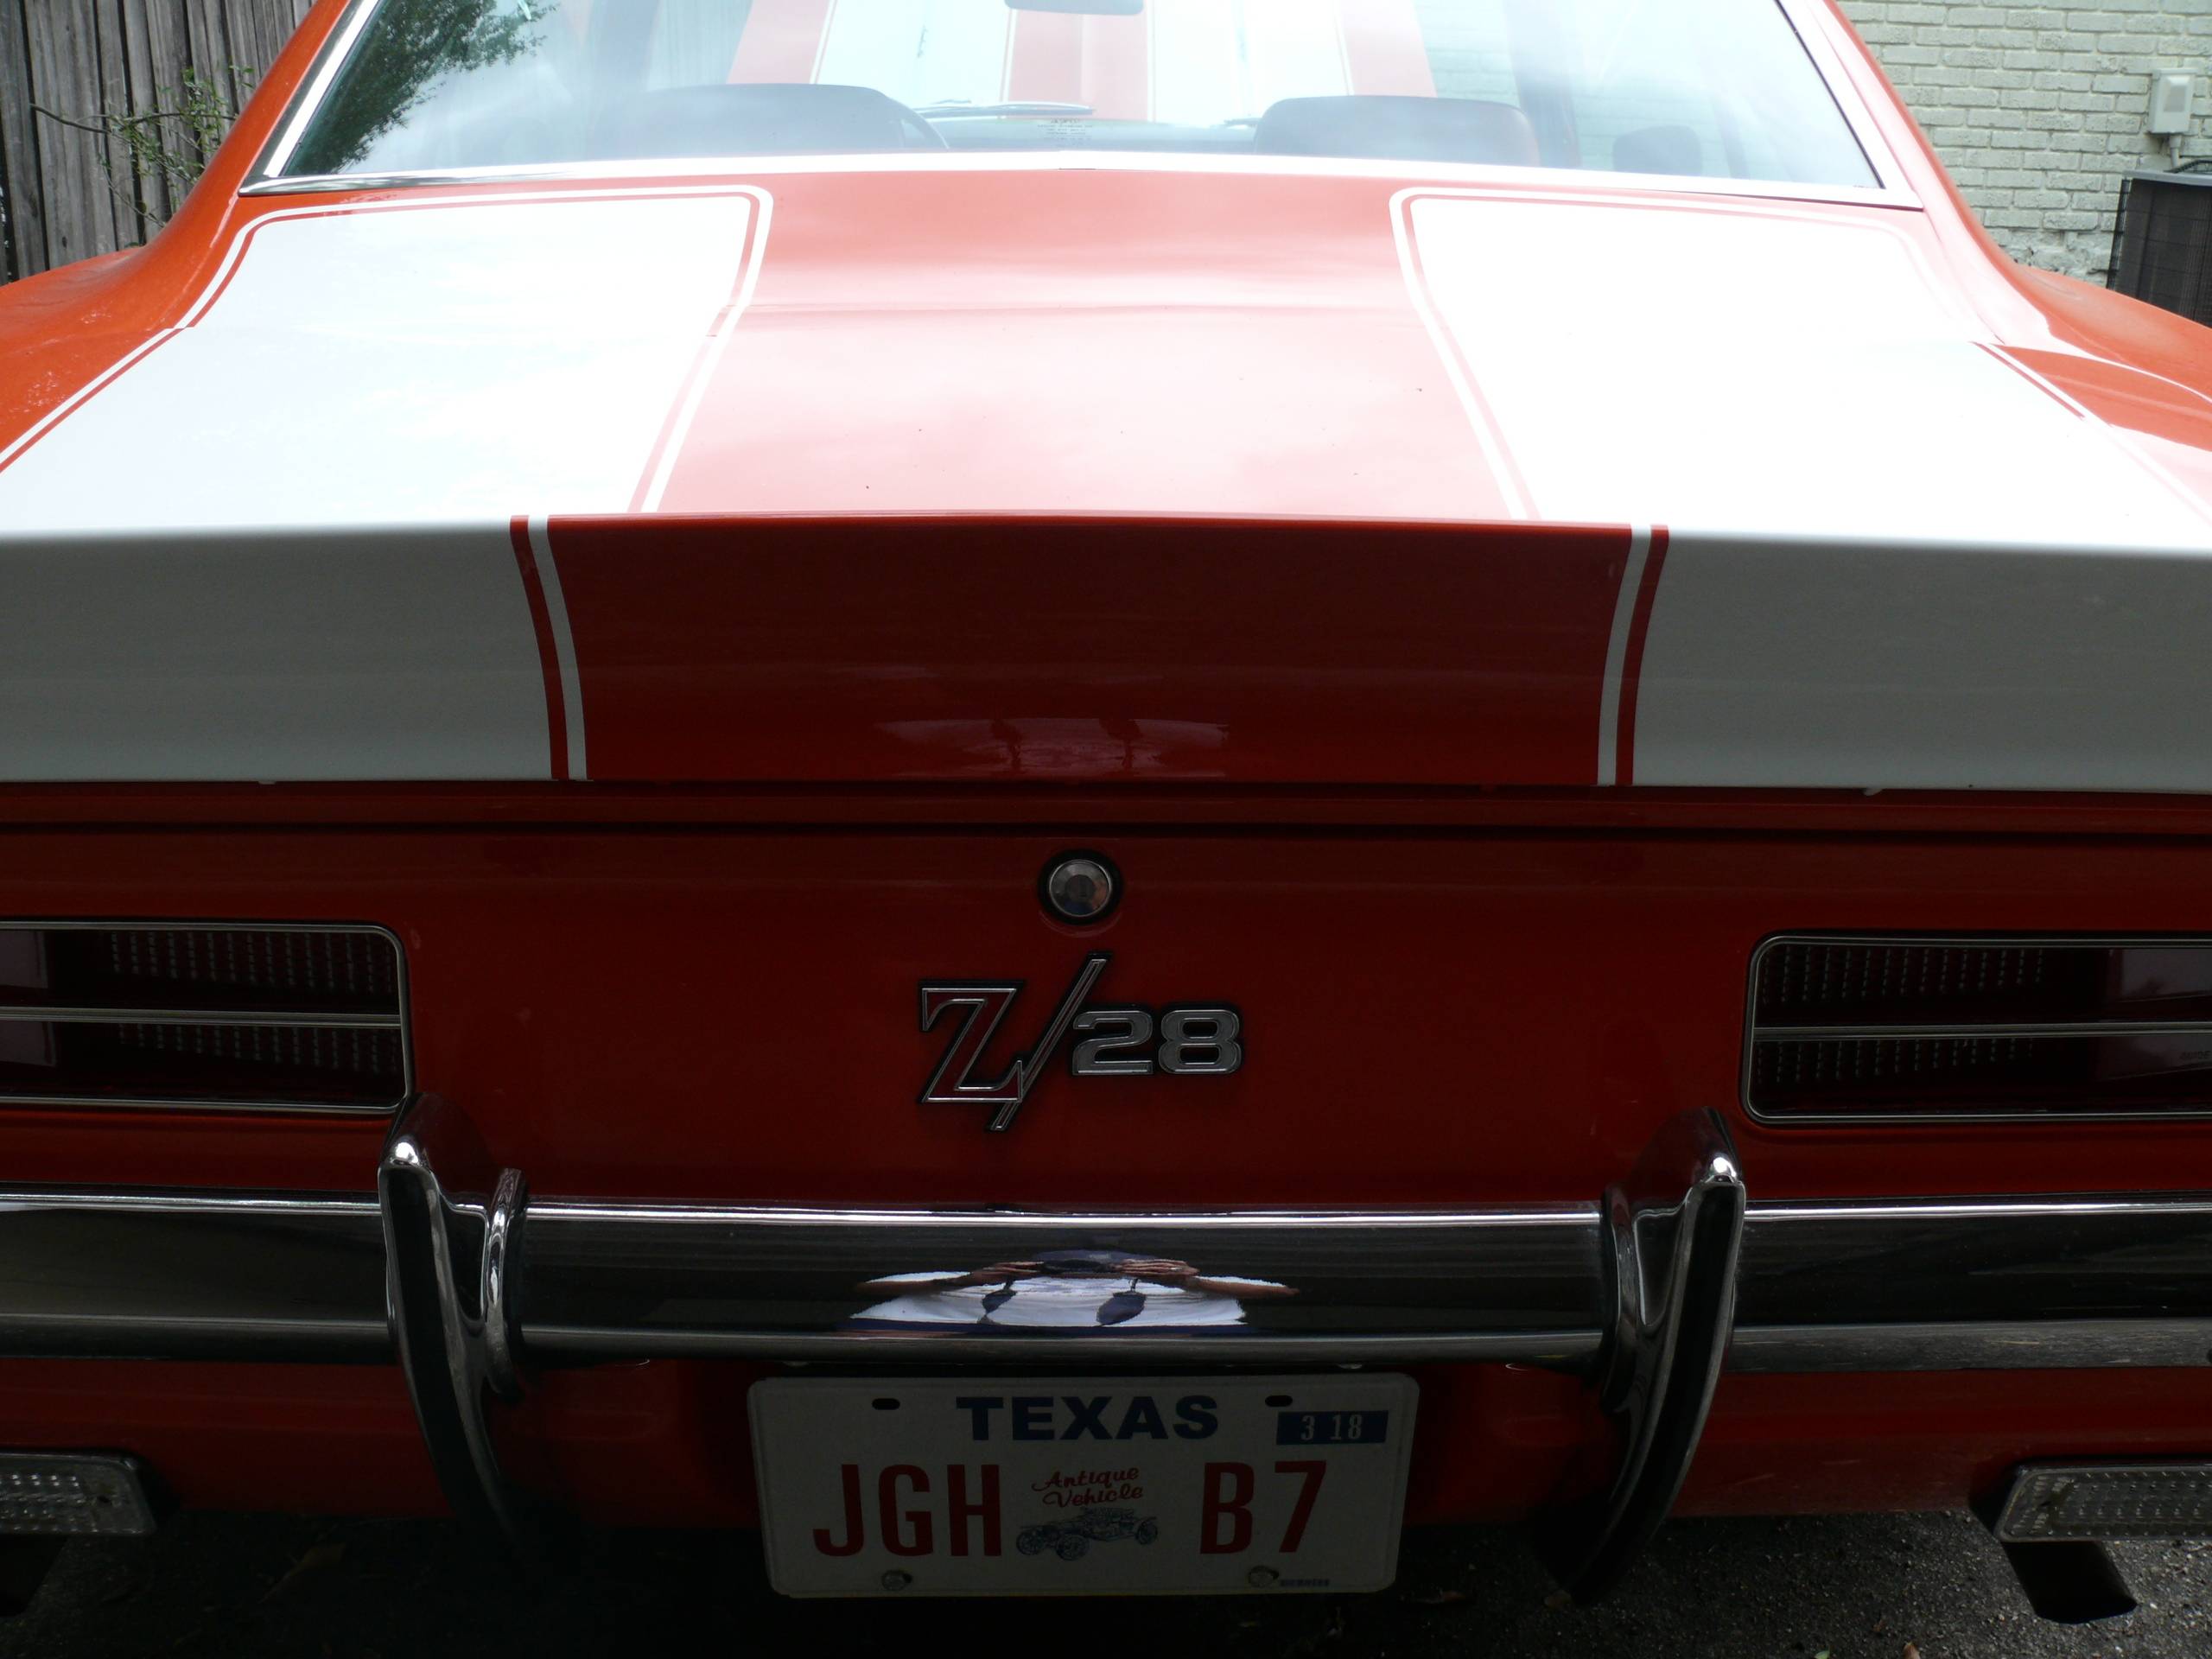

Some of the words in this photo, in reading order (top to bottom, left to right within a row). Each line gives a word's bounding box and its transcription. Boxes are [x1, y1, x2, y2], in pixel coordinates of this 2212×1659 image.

[919, 954, 1244, 1131] Z/28
[956, 1395, 1218, 1441] TEXAS
[1300, 1414, 1315, 1441] 3
[1329, 1414, 1363, 1440] 18
[1031, 1467, 1139, 1491] Antique
[1042, 1483, 1143, 1508] Vehicle
[812, 1463, 1002, 1558] JGH
[1199, 1460, 1327, 1554] B7
